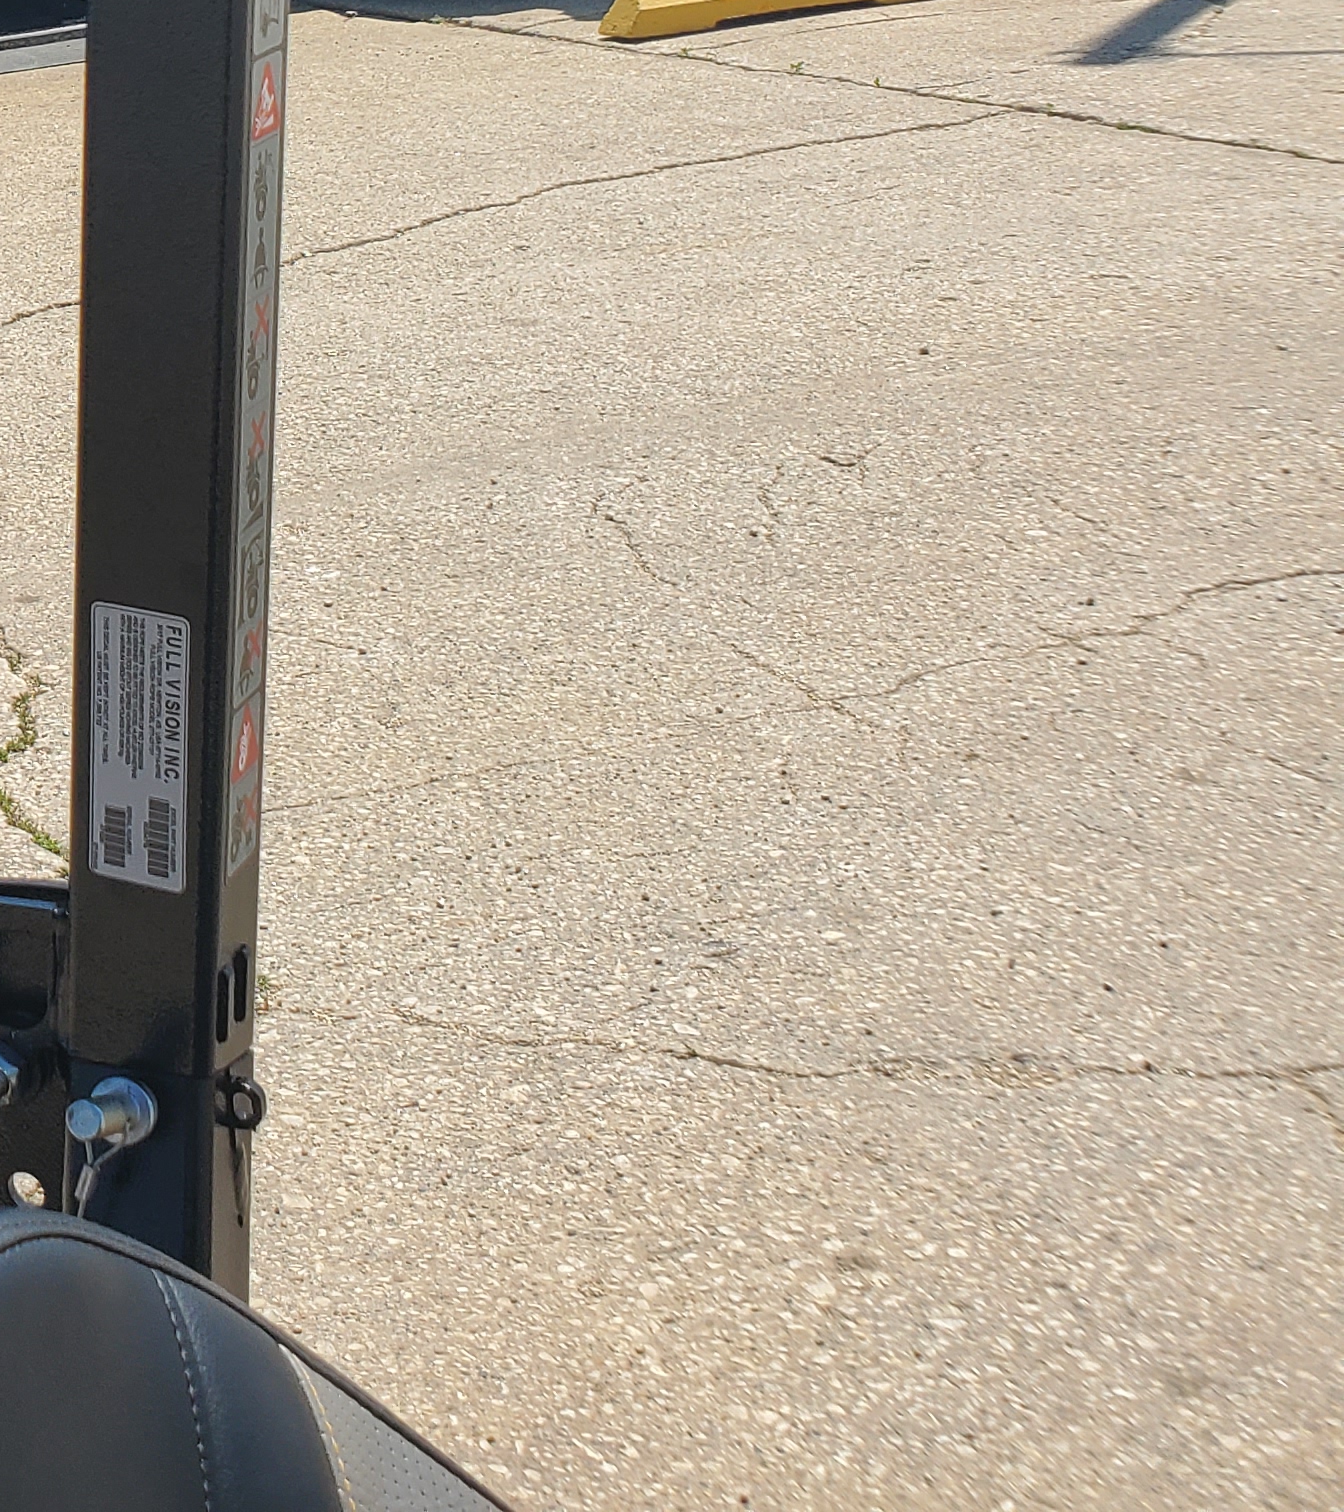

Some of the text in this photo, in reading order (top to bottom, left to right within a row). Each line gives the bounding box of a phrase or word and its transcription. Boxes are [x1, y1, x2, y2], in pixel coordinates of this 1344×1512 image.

[164, 625, 182, 784] FULL VISION INC.
